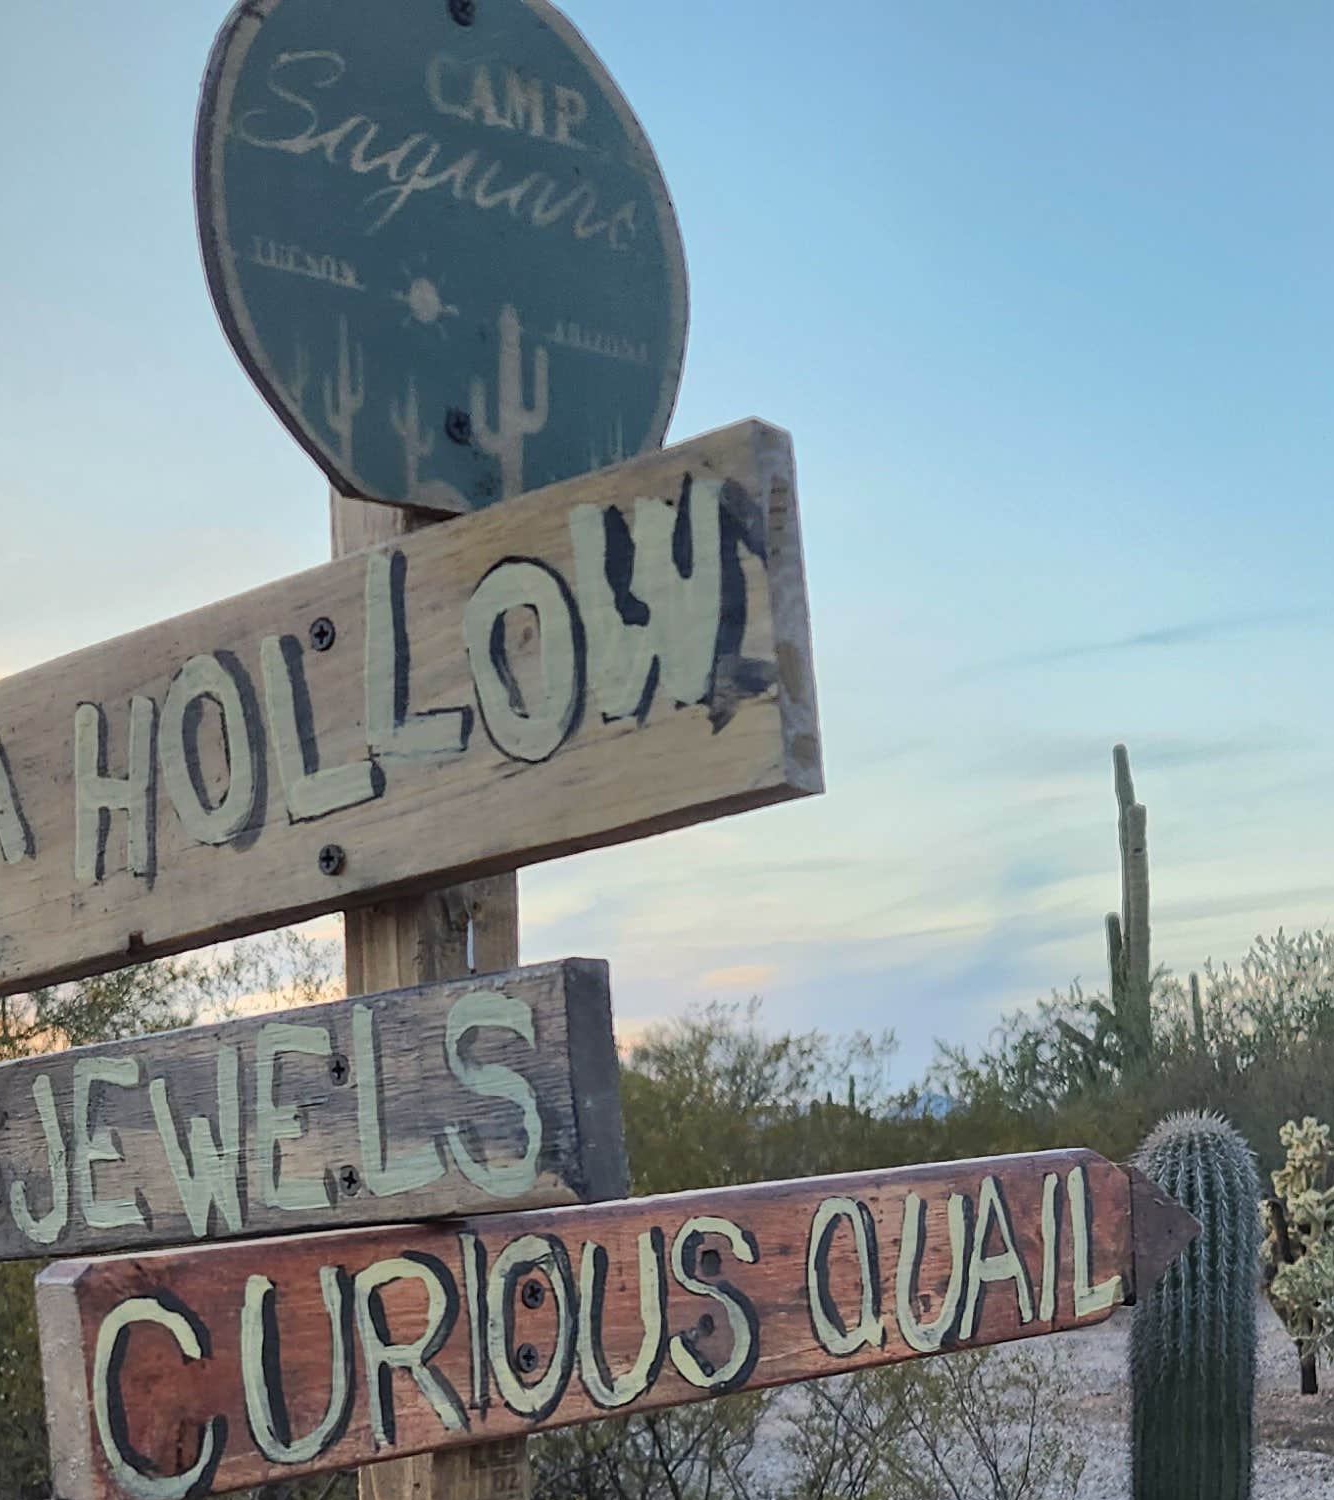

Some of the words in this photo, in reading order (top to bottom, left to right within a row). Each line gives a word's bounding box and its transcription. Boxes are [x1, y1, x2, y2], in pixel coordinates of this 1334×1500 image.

[238, 51, 636, 250] Saguaro
[426, 55, 591, 150] CAMP
[74, 472, 765, 888] HOLLOW
[10, 991, 543, 1242] JEWELS
[805, 1164, 1123, 1355] QUAIL
